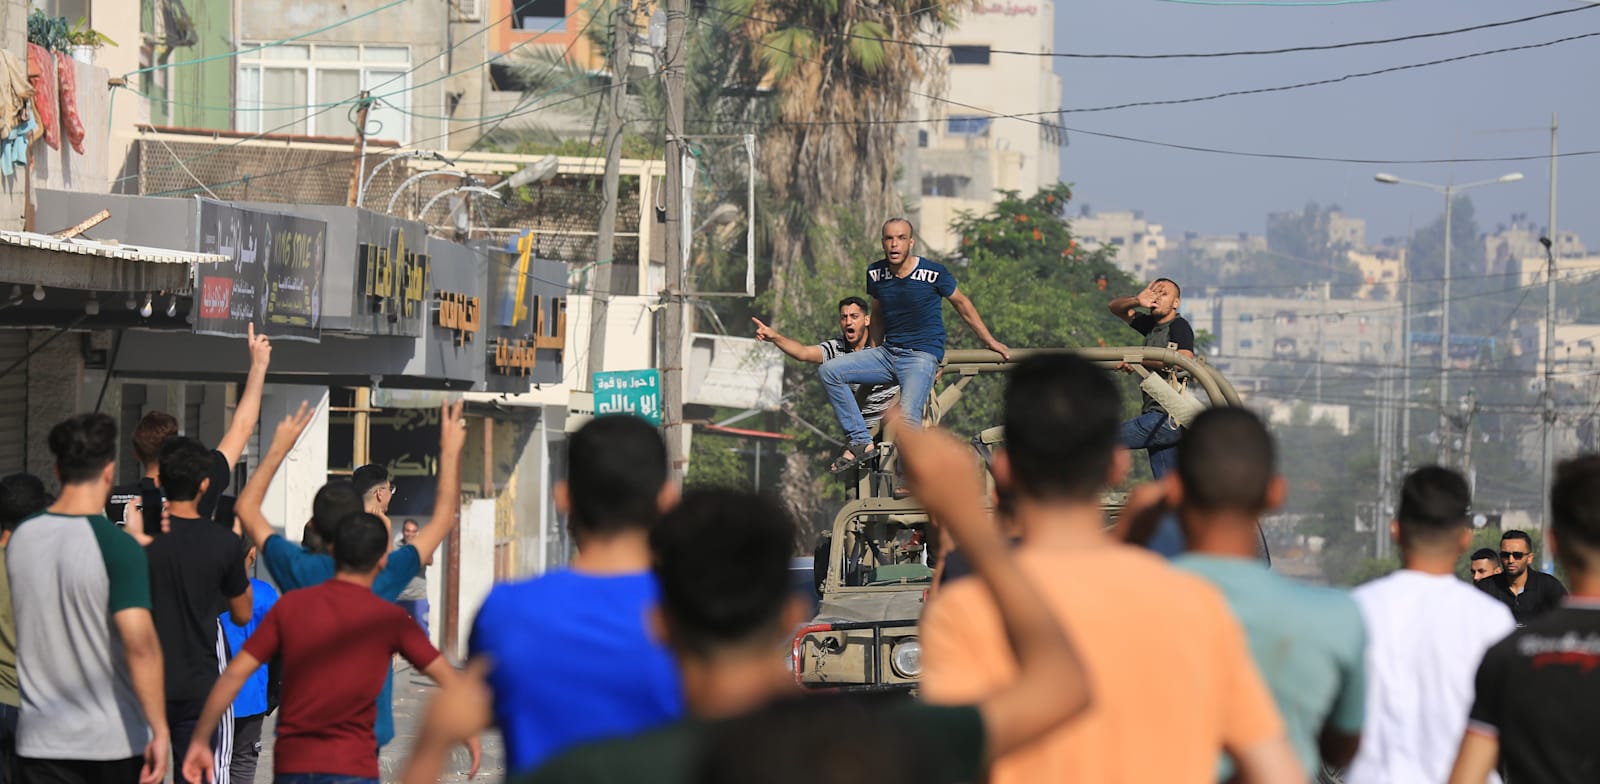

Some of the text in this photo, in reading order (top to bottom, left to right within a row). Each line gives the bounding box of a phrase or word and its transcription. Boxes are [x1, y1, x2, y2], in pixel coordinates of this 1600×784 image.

[597, 376, 655, 389] لا حول ولا قوة
[599, 393, 659, 418] إلا بالله
